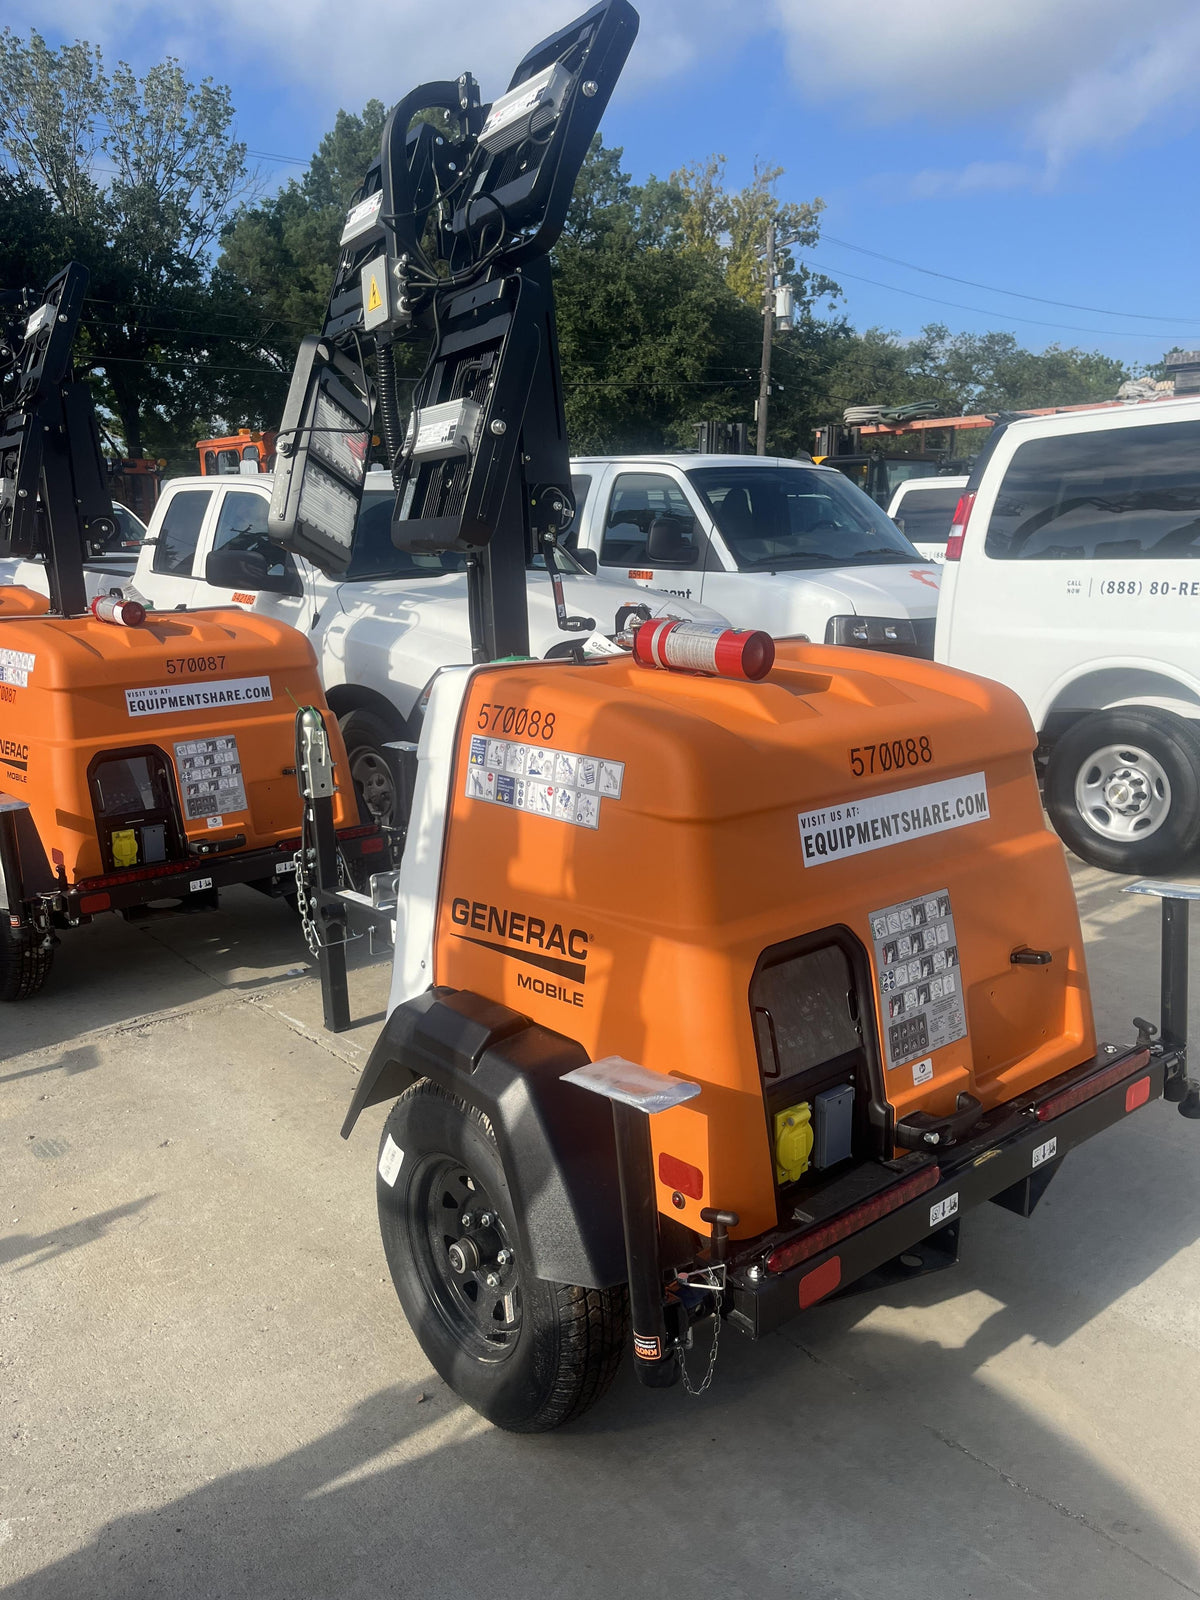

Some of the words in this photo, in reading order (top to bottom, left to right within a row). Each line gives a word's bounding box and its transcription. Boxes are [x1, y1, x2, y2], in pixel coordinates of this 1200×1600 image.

[1100, 580, 1143, 596] (888)
[166, 655, 226, 674] 570087
[129, 686, 271, 713] EQUIPMENTSHARE.COM
[477, 703, 556, 741] 570088
[850, 735, 933, 777] 570088
[7, 771, 27, 783] MOBILE
[800, 813, 826, 829] VISIT
[830, 811, 842, 822] US
[846, 806, 860, 818] AT:
[803, 792, 987, 859] EQUIPMENTSHARE.COM
[517, 973, 584, 1008] MOBILE
